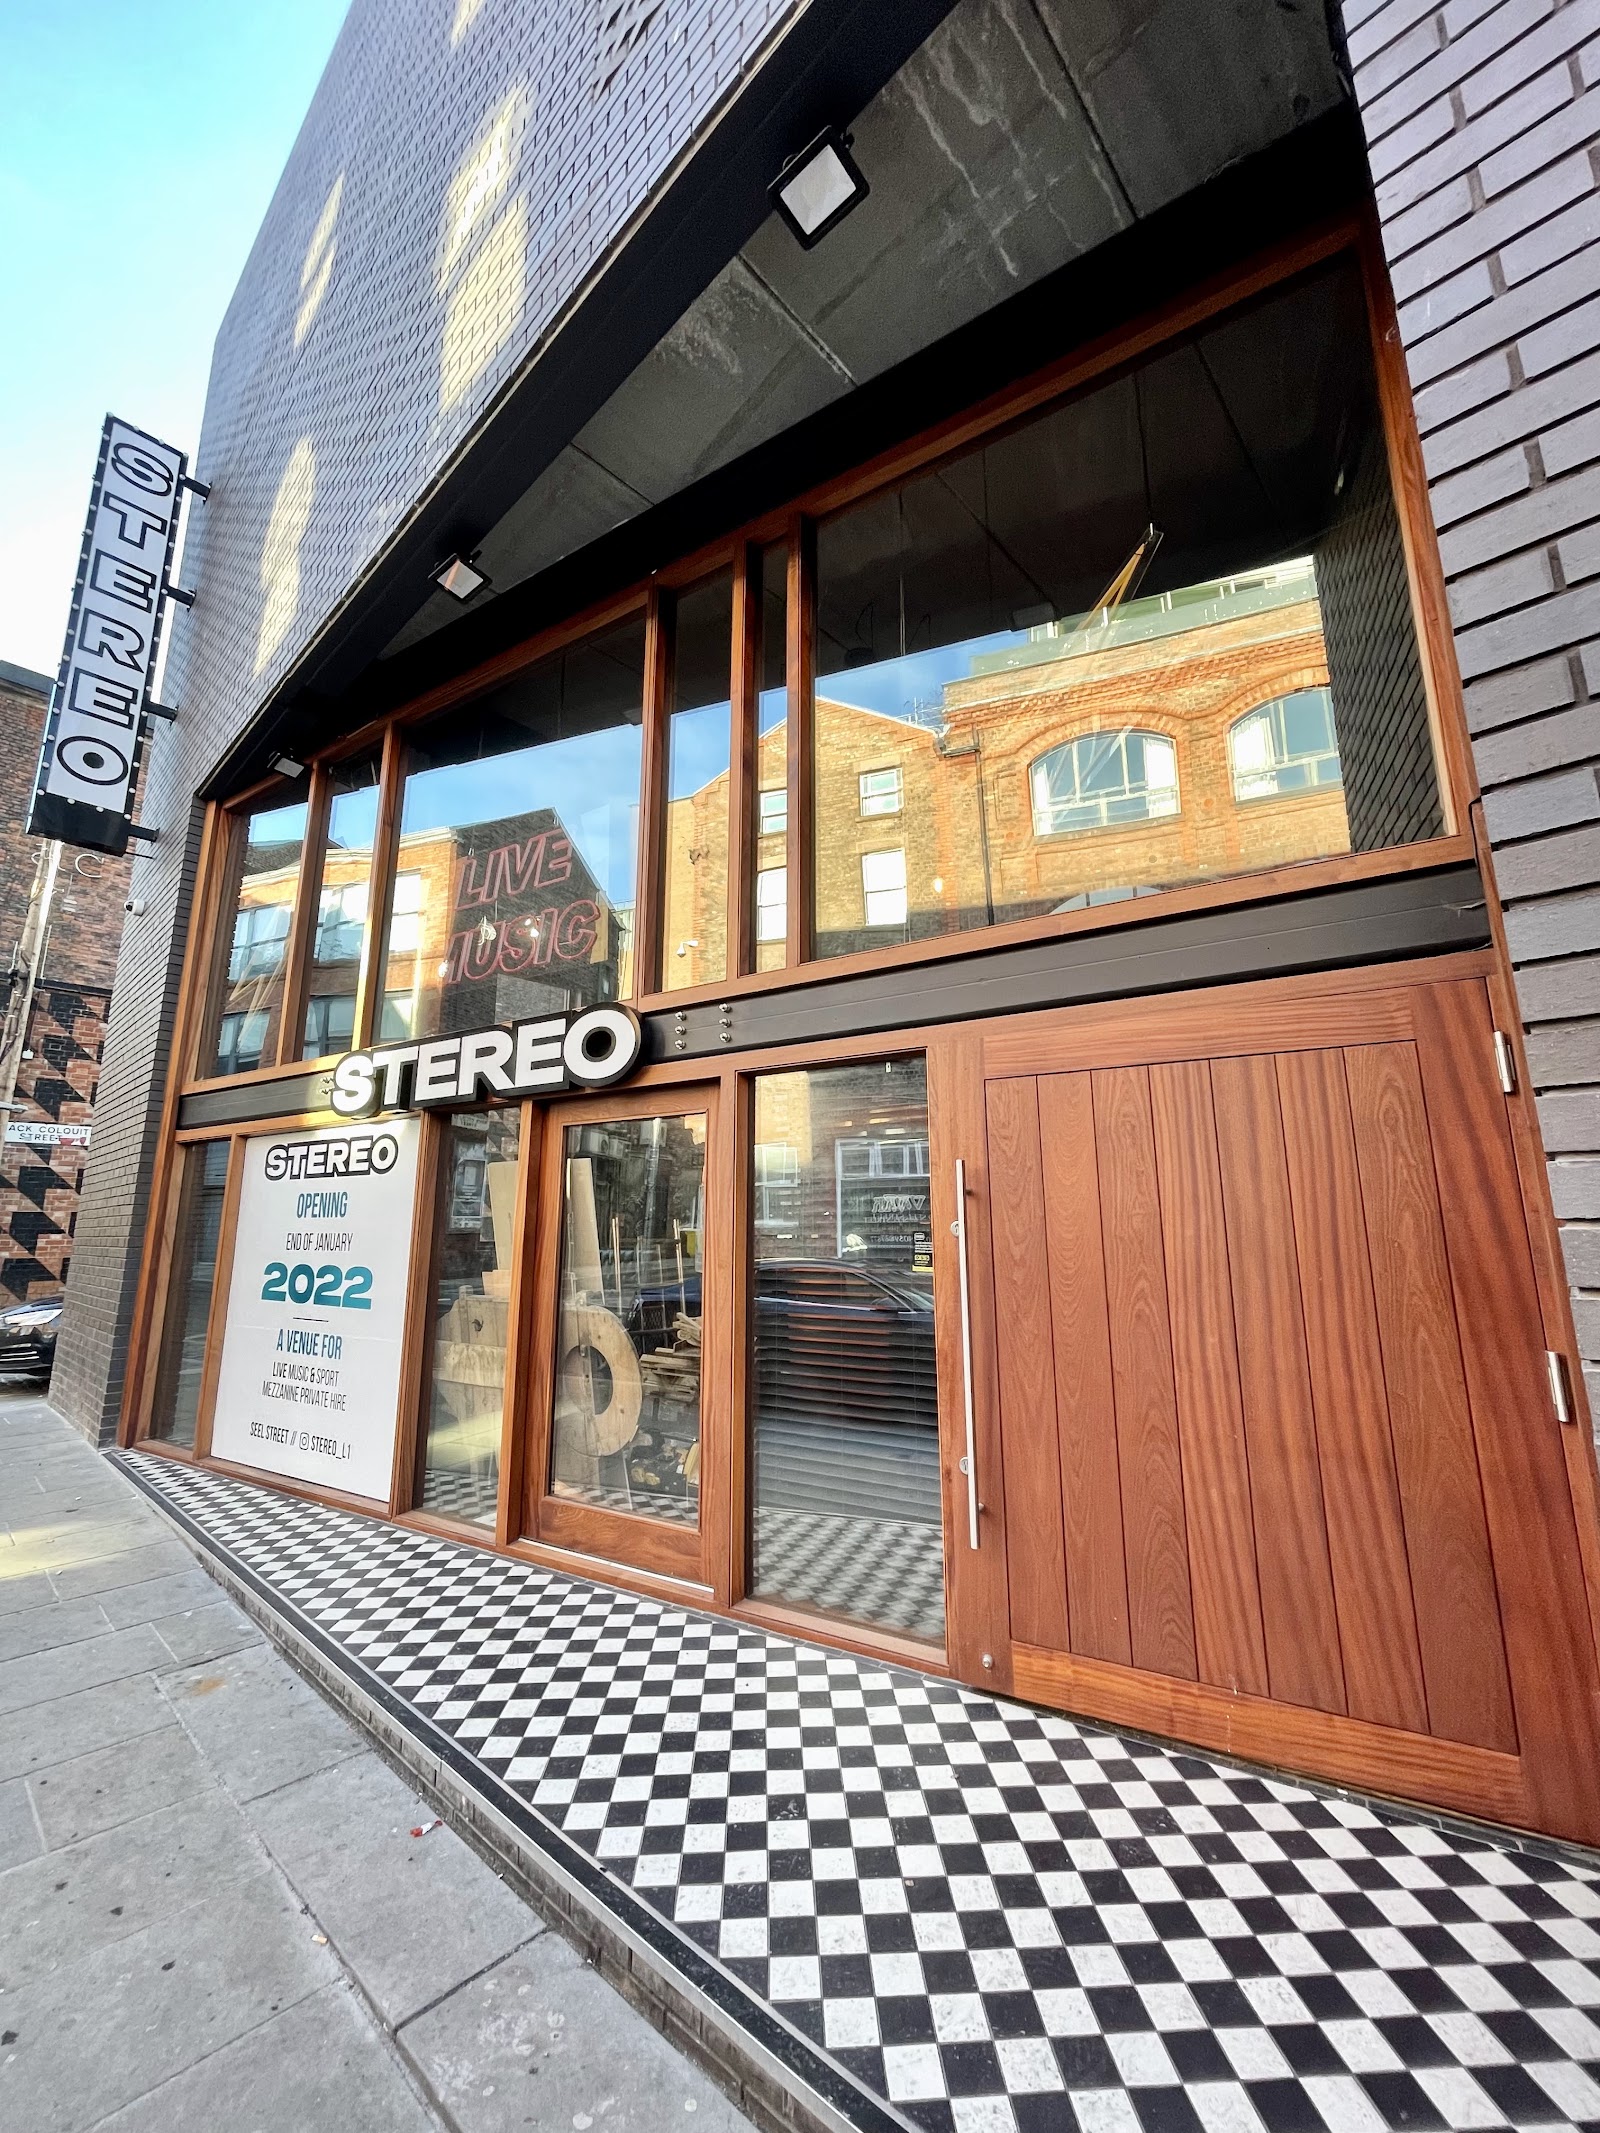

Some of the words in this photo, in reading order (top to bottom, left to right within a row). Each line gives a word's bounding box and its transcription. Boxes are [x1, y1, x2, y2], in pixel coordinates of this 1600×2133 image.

[57, 443, 174, 786] STEREO
[455, 828, 573, 911] LIVE
[331, 1003, 642, 1116] STEREO
[8, 1124, 33, 1132] ACK
[265, 1134, 399, 1181] STEREO
[296, 1191, 348, 1218] OPENING
[286, 1232, 302, 1251] END
[303, 1232, 314, 1251] OF
[314, 1232, 353, 1251] JANUARY
[261, 1262, 373, 1310] 2022
[276, 1328, 284, 1351] A
[287, 1329, 320, 1356] VENUE
[321, 1334, 342, 1360] FOR
[273, 1361, 288, 1378] LIVE
[288, 1363, 309, 1382] MUSIC
[310, 1367, 315, 1383] &
[316, 1368, 339, 1387] SPORT
[262, 1380, 300, 1402] MEZZANINE
[300, 1387, 329, 1408] PRIVATE
[330, 1392, 347, 1411] HIRE
[250, 1421, 264, 1439] SEEL
[265, 1425, 289, 1444] STREET
